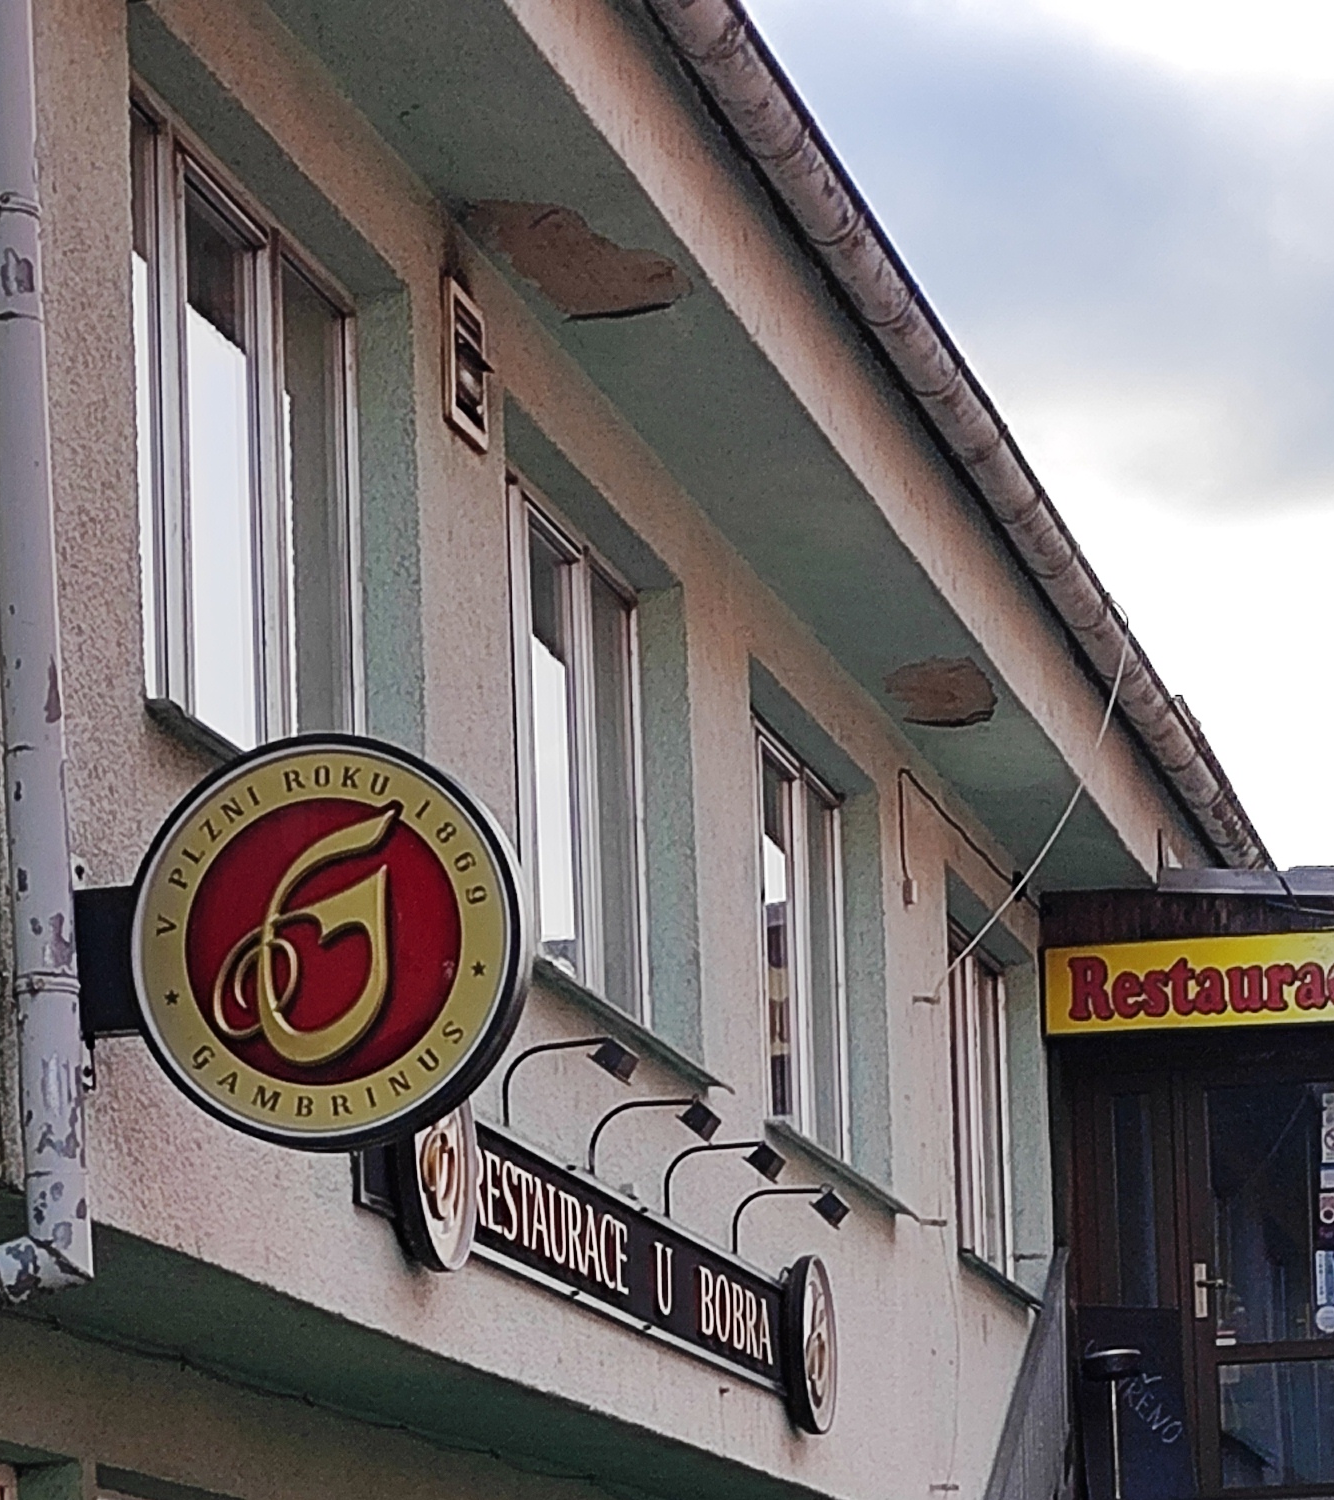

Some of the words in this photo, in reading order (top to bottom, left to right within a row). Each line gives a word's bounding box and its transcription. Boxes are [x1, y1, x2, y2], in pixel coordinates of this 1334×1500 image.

[156, 913, 178, 937] V
[168, 786, 262, 890] PLZNI
[283, 764, 391, 797] ROKU
[412, 799, 487, 906] 1869
[191, 1020, 465, 1117] GAMBRINUS
[654, 1241, 673, 1316] U
[699, 1265, 773, 1366] BOBRA
